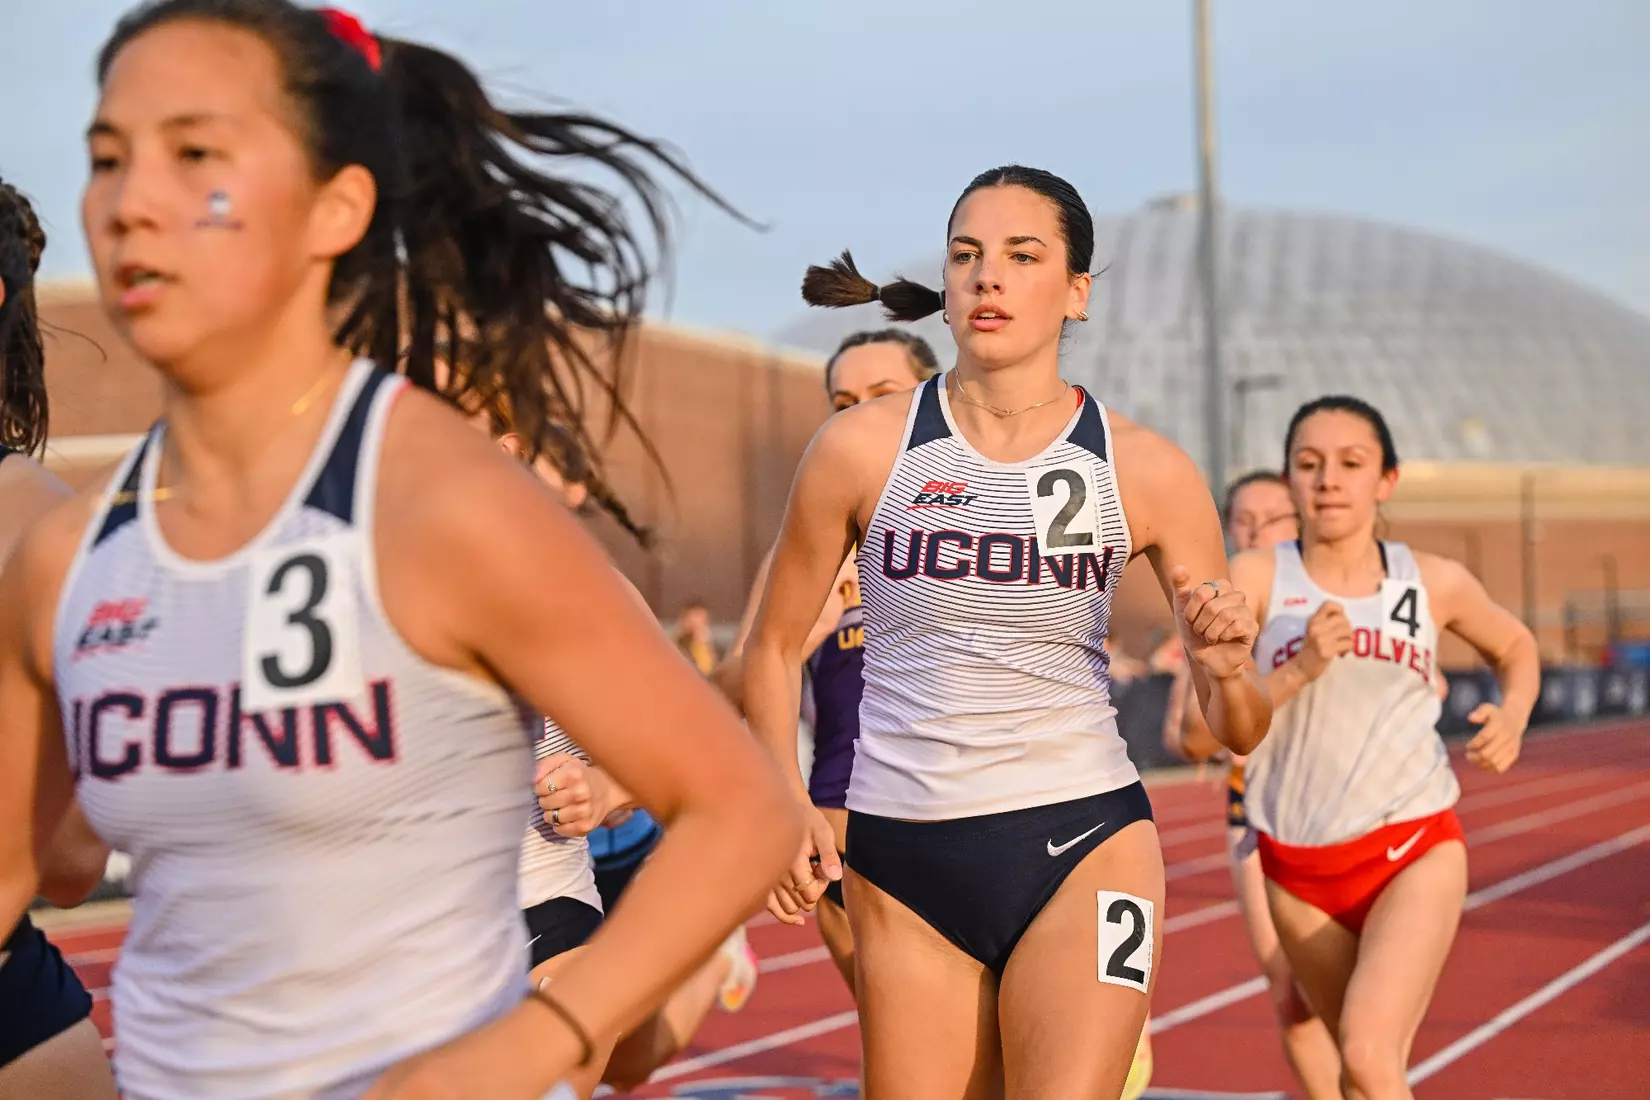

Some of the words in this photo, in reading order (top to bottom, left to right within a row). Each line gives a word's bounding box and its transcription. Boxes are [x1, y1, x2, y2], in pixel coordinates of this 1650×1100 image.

[912, 493, 978, 506] EAST
[921, 481, 968, 494] BIG
[1037, 469, 1093, 549] 2
[883, 529, 1115, 592] UCONN
[261, 553, 333, 689] 3
[1390, 586, 1421, 638] 4
[1106, 899, 1145, 984] 2
